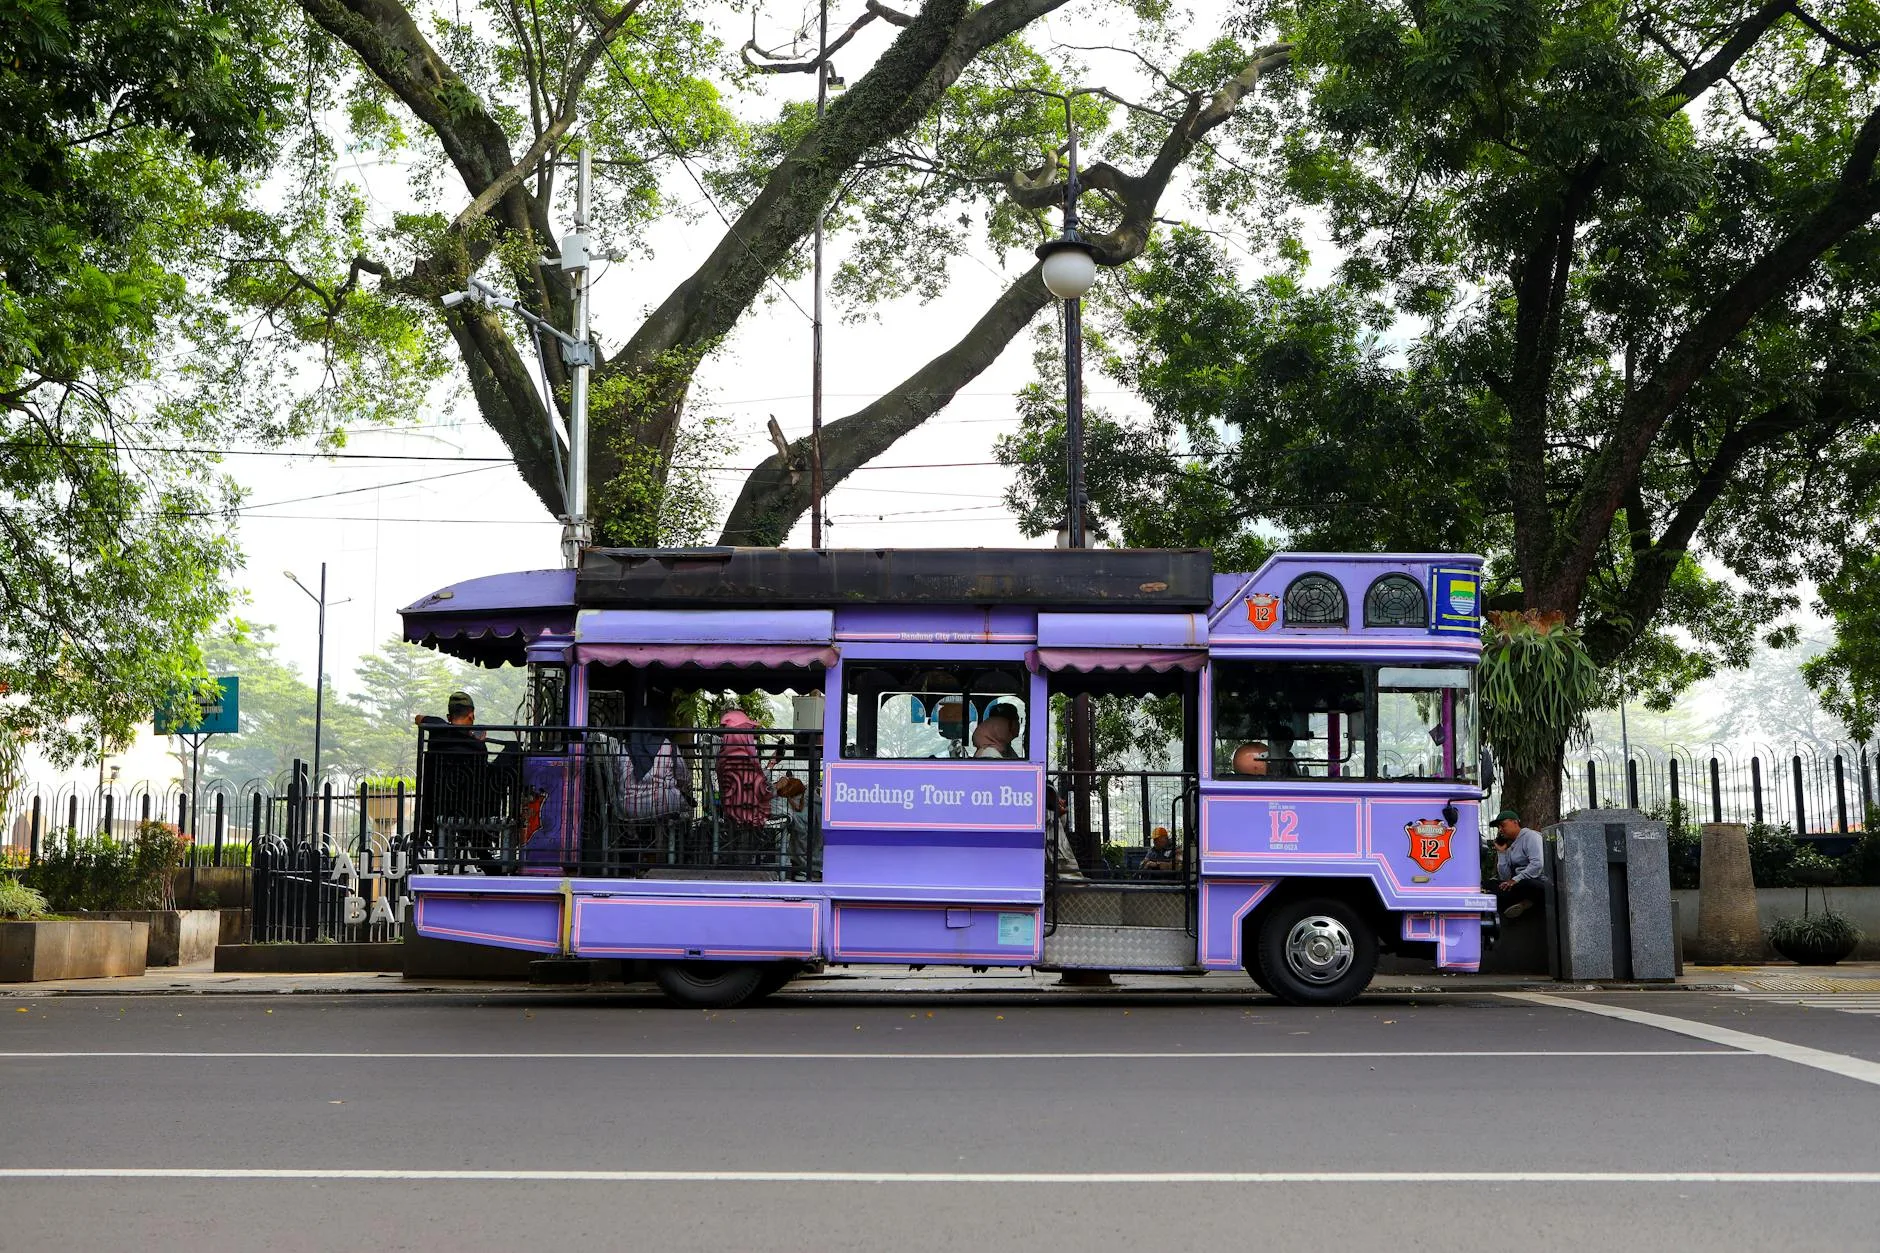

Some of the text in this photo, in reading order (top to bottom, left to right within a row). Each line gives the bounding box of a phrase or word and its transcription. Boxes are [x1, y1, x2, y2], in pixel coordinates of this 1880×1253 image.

[1255, 606, 1270, 622] 12
[835, 782, 1033, 809] Bandung Tour on Bus
[1269, 810, 1299, 842] 12
[1421, 839, 1440, 859] 12
